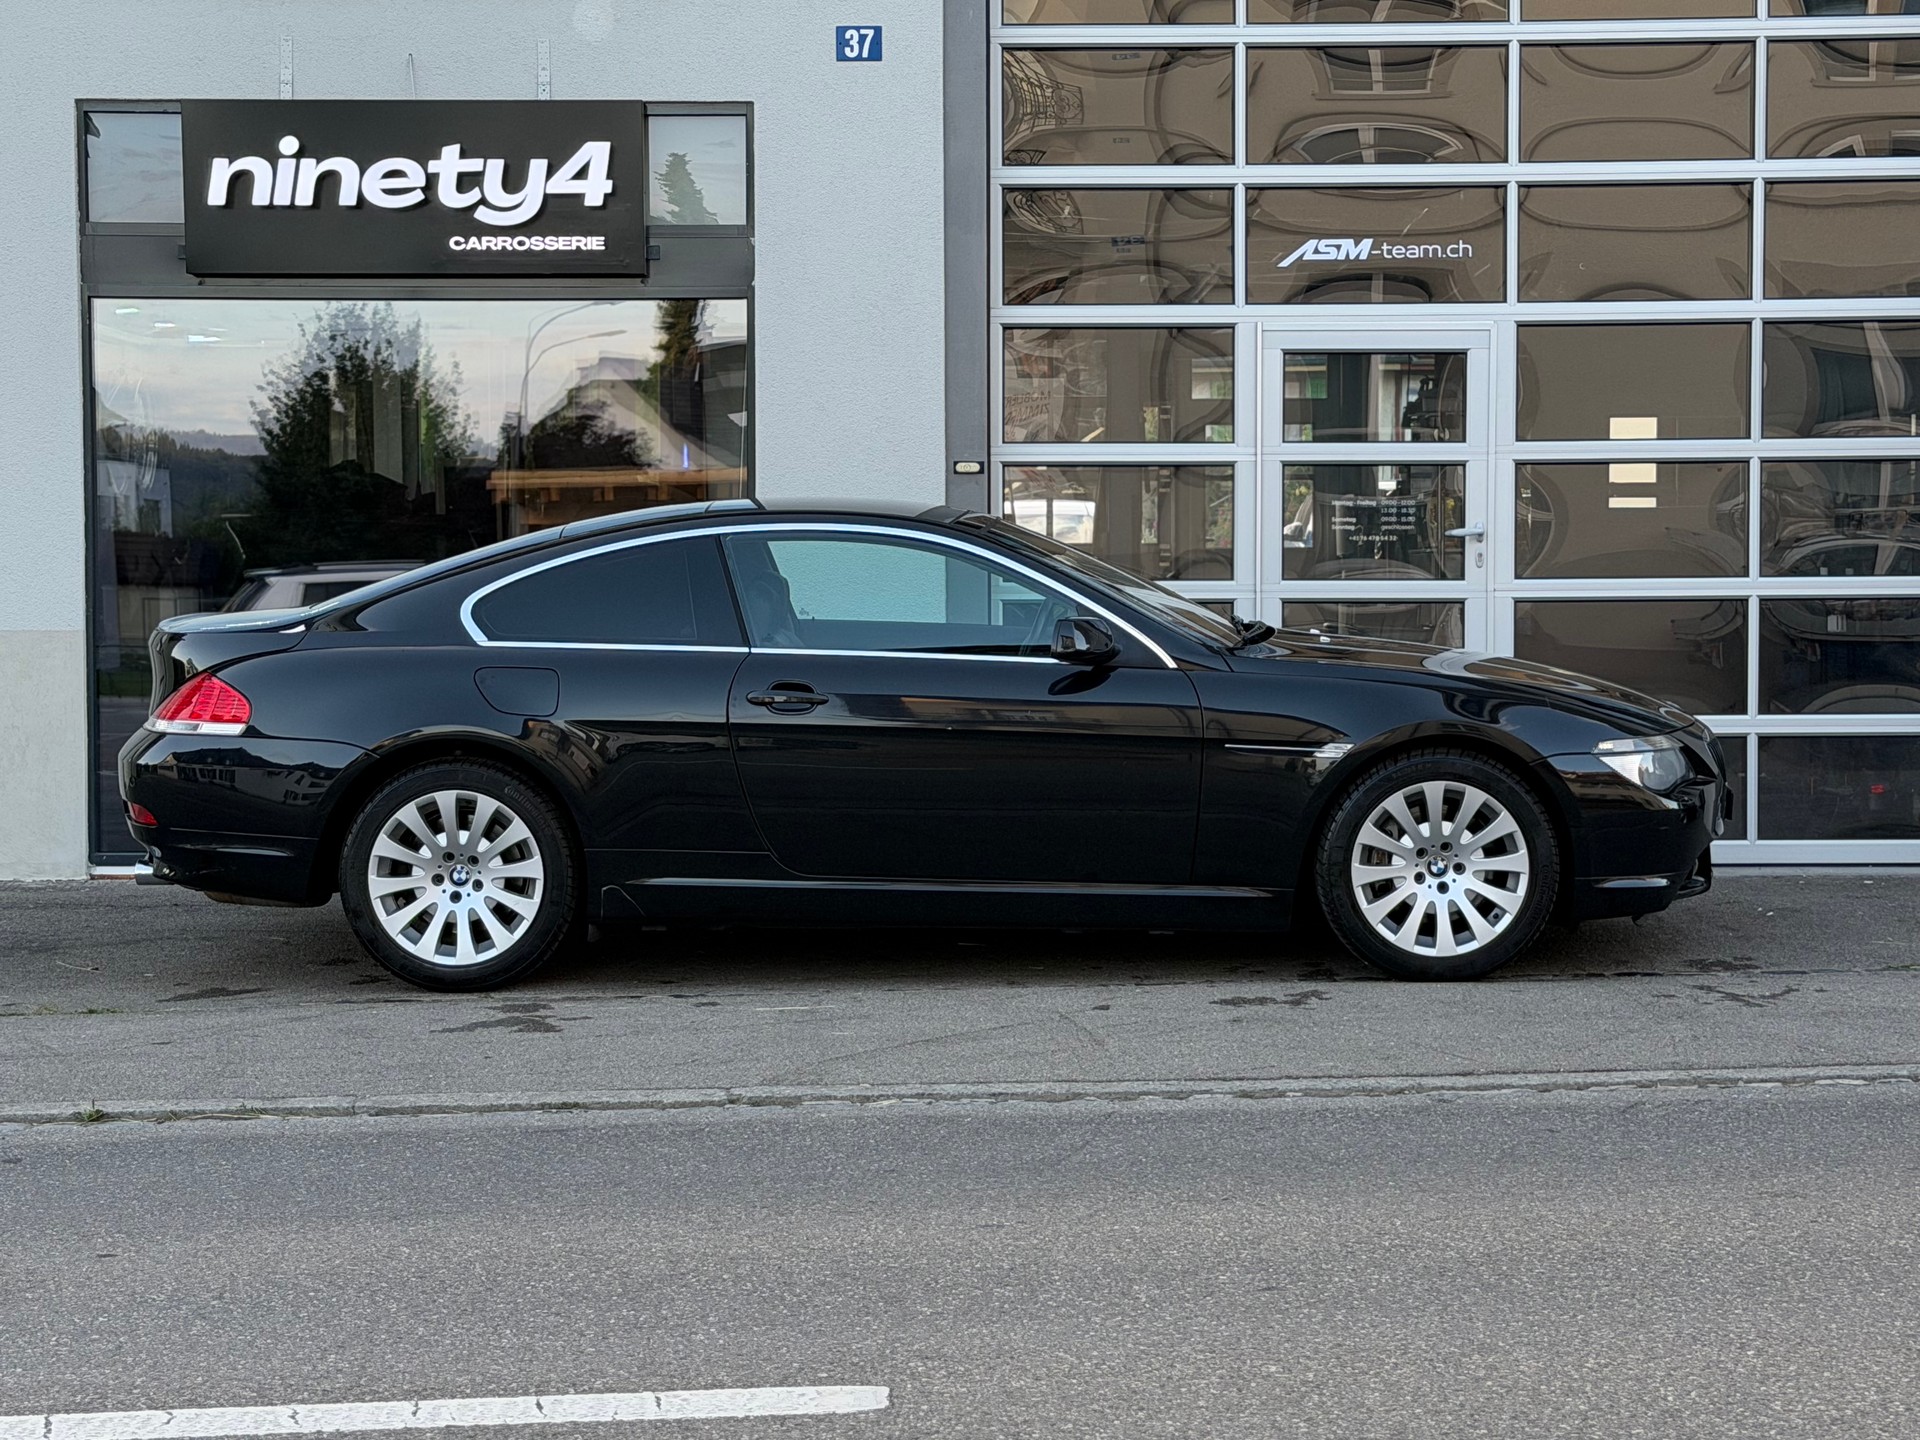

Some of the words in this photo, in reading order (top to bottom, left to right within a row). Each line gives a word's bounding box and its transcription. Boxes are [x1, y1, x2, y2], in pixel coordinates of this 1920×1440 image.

[844, 29, 875, 58] 37
[207, 135, 613, 226] ninety4
[449, 236, 606, 251] CARROSSERIE
[1276, 238, 1473, 267] ASM-team.ch
